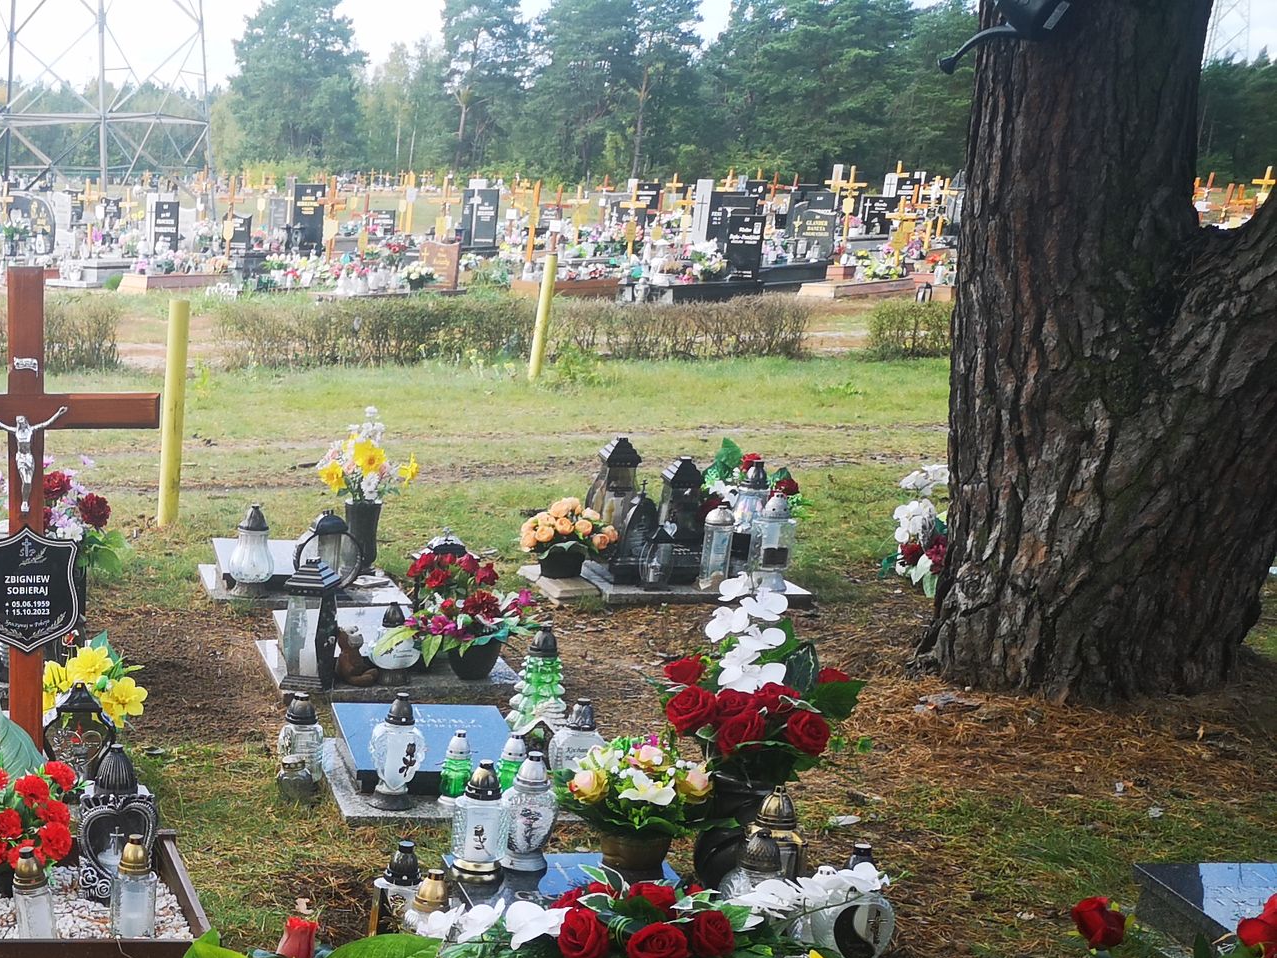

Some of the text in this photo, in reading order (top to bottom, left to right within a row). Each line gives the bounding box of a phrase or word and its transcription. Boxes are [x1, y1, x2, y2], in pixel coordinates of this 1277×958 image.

[4, 575, 51, 584] ZBIGNIEW
[7, 586, 49, 596] SOBIERAJ
[11, 600, 51, 608] 05.06.1959
